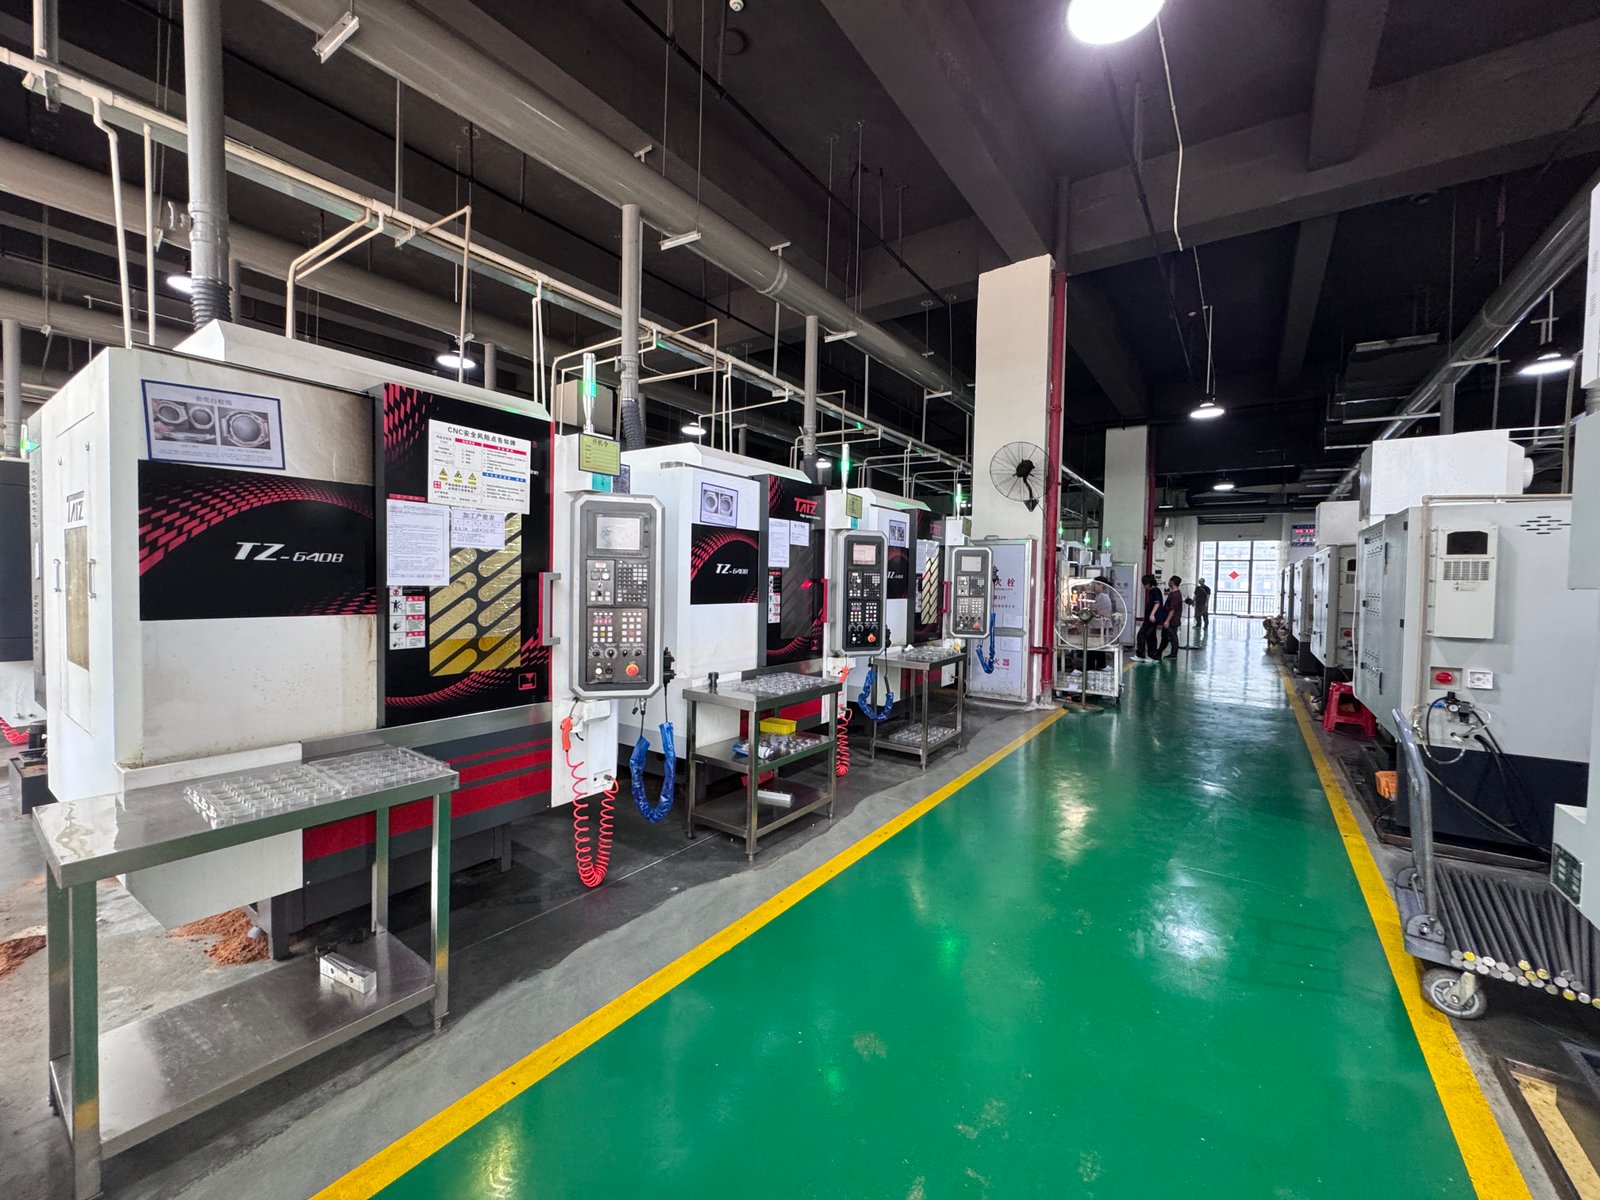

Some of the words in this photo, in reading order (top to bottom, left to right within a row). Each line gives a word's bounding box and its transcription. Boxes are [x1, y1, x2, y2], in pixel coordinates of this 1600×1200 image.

[447, 426, 516, 447] CNC安全风险点告知牌
[234, 541, 344, 563] TZ-640B
